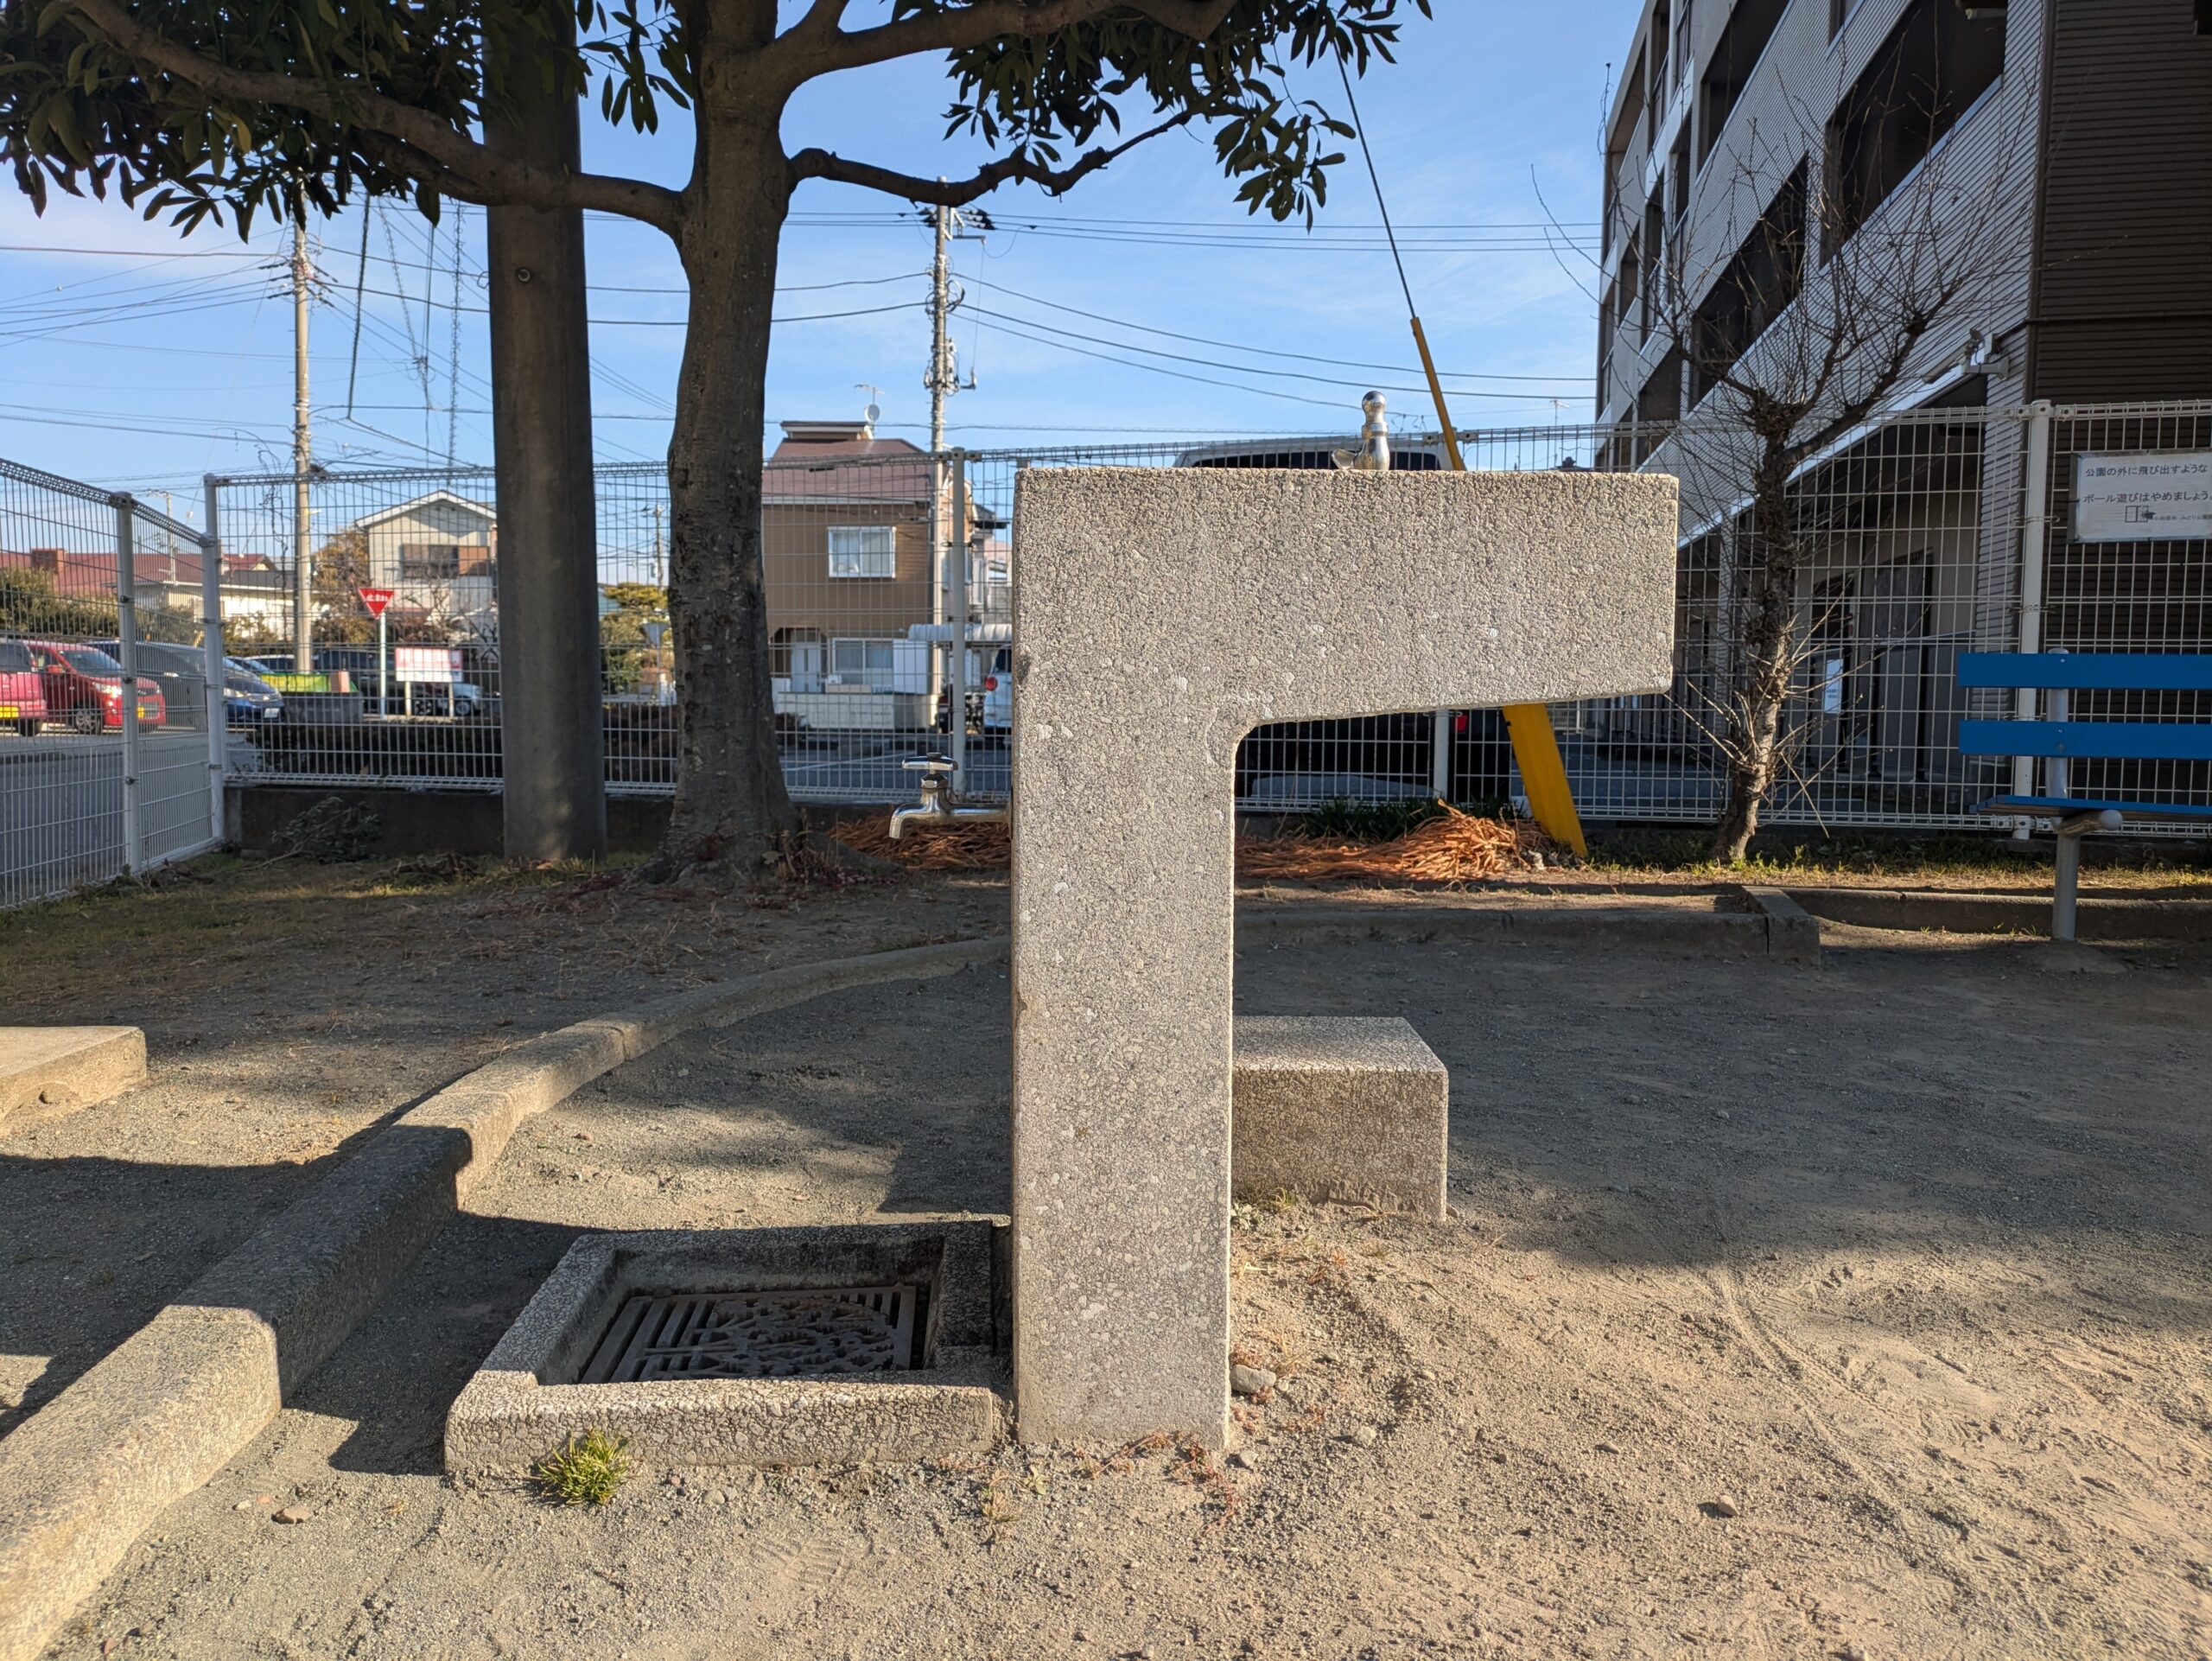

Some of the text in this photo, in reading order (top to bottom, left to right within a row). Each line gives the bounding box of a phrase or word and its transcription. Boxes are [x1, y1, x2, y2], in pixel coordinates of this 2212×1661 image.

[2086, 464, 2208, 476] 公園の外に飛び出すような
